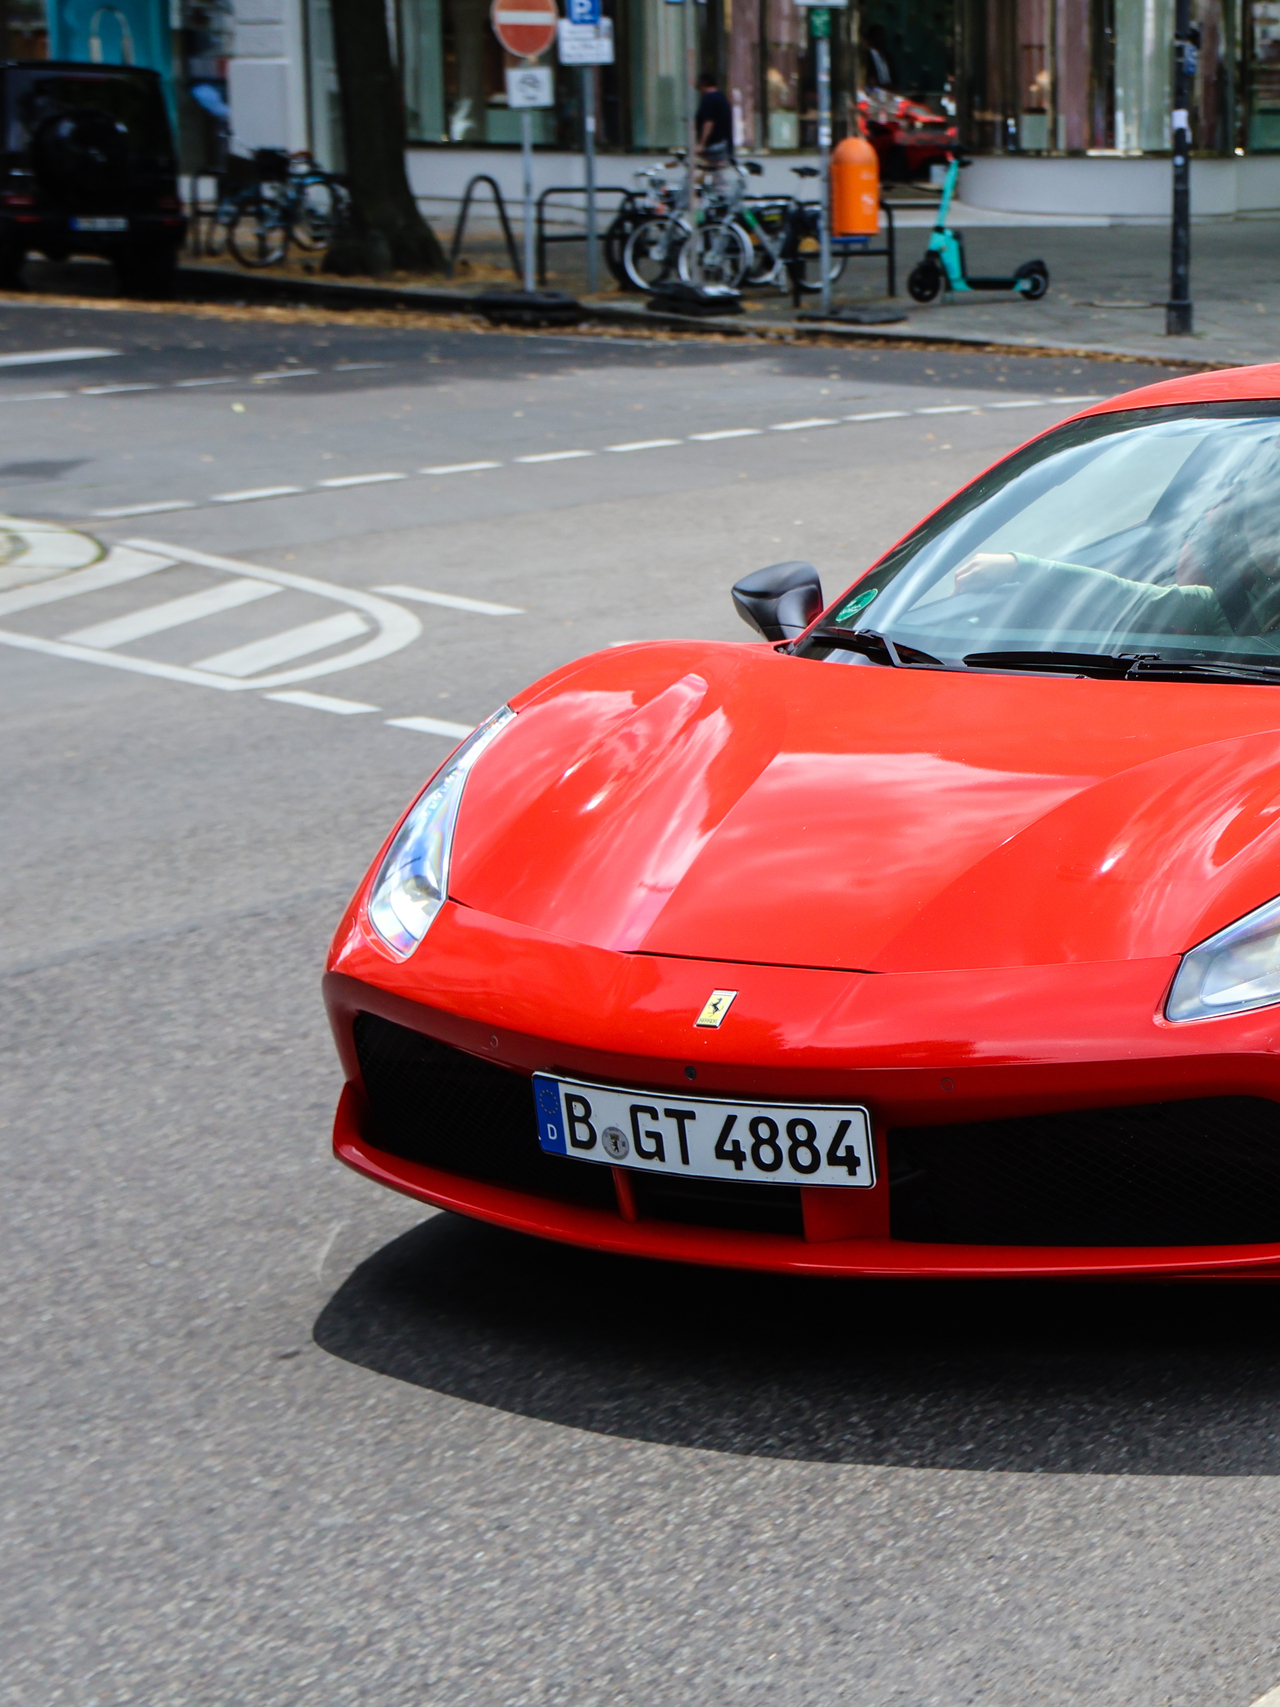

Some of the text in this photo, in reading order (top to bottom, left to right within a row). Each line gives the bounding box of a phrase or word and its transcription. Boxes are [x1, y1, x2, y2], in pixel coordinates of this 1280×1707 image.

[547, 1123, 558, 1140] D
[564, 1092, 598, 1150] B
[629, 1104, 697, 1166] GT
[714, 1114, 861, 1176] 4884
